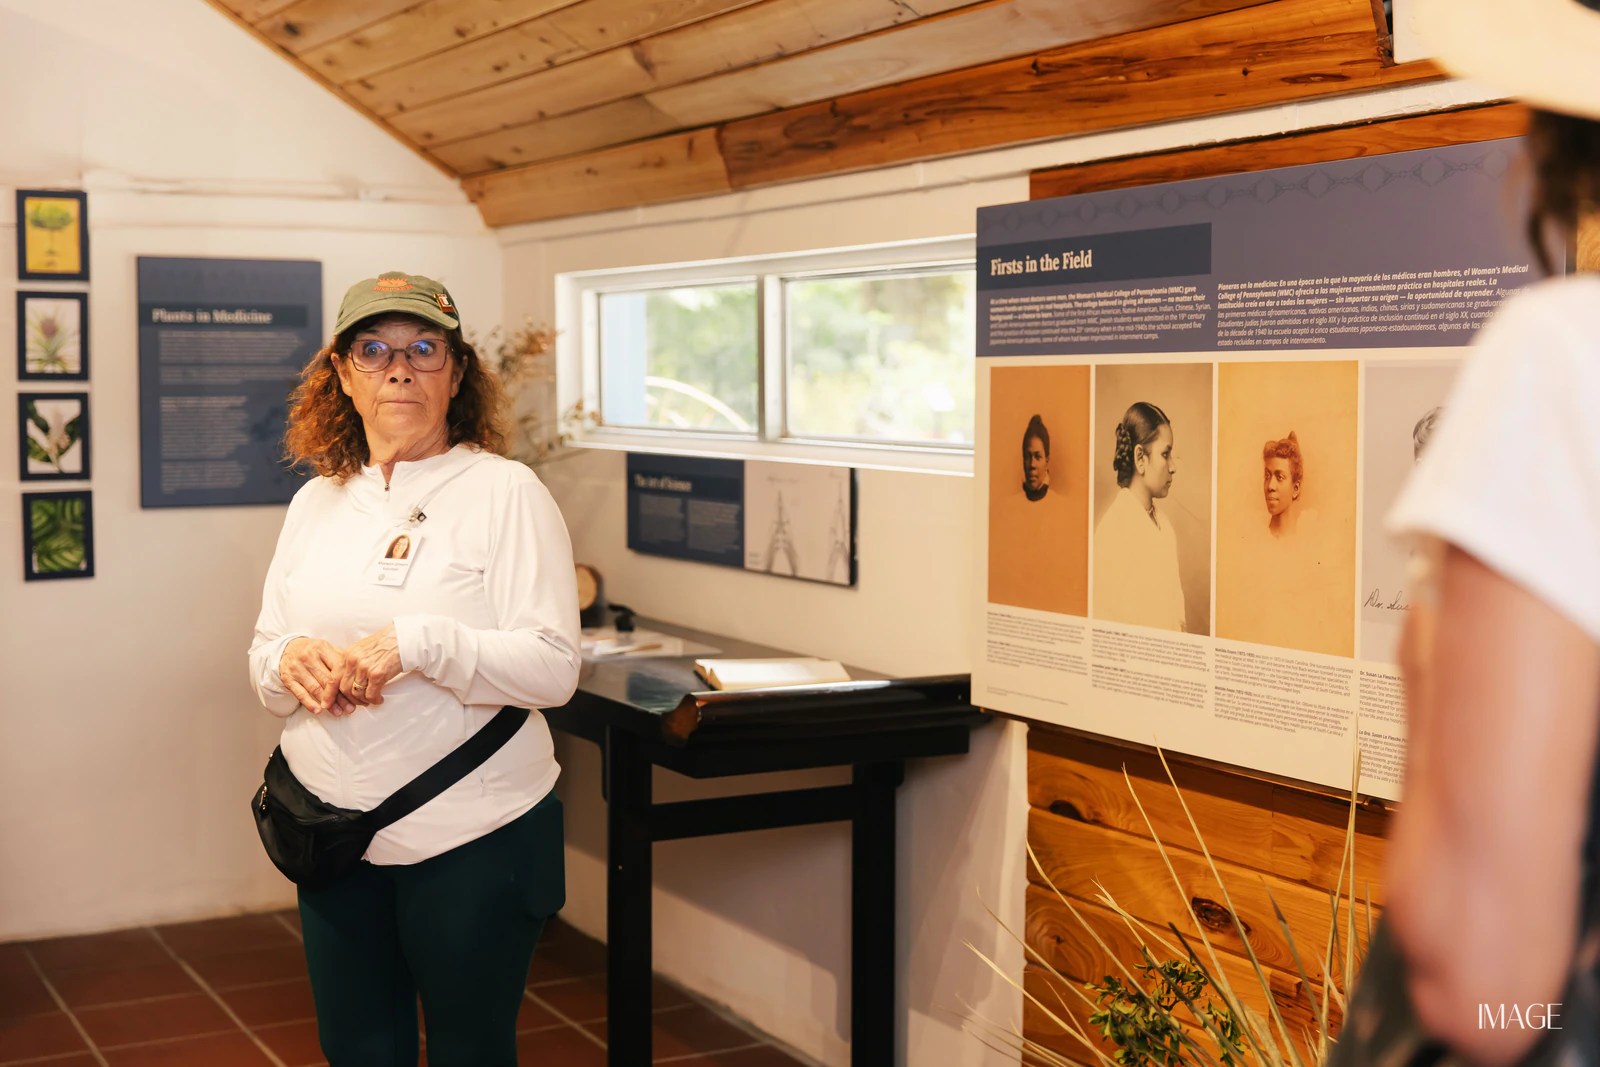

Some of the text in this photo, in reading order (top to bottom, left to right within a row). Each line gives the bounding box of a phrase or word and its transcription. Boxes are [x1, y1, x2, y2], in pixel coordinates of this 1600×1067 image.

[990, 248, 1093, 276] Firsts in the Field
[1218, 282, 1239, 290] Pioneras
[1247, 281, 1253, 289] la
[1280, 279, 1286, 287] En
[1299, 277, 1315, 287] época
[1324, 276, 1329, 284] la
[1330, 277, 1341, 286] que
[1342, 275, 1348, 283] la
[1348, 274, 1372, 285] mayoría
[1373, 273, 1381, 281] de
[1382, 273, 1391, 281] los
[1392, 271, 1417, 280] médicos
[1433, 269, 1462, 279] hombres,
[1464, 268, 1470, 276] el
[1502, 265, 1529, 274] Medical
[1185, 286, 1196, 294] gave
[1218, 291, 1236, 301] College
[1237, 291, 1243, 299] of
[1243, 289, 1276, 300] Pennsylvania
[1277, 288, 1295, 298] (WMC)
[1320, 286, 1328, 294] las
[1329, 285, 1352, 295] mujeres
[1353, 282, 1396, 292] entrenamiento
[1397, 281, 1422, 292] práctico
[1432, 278, 1465, 290] hospitales
[1466, 277, 1488, 286] reales.
[1489, 277, 1497, 285] La
[1175, 295, 1192, 303] matter
[1193, 294, 1206, 302] their
[1218, 301, 1244, 309] institución
[1266, 299, 1275, 307] dar
[1281, 298, 1296, 306] todas
[1306, 296, 1328, 307] mujeres
[1336, 296, 1344, 304] sin
[1345, 294, 1370, 305] importar
[1380, 293, 1399, 303] origen
[1407, 292, 1414, 300] la
[1414, 290, 1453, 302] oportunidad
[1454, 290, 1462, 298] de
[1464, 288, 1494, 299] aprender.
[152, 307, 274, 324] Plants in Medicine
[1196, 303, 1212, 312] Syrian,
[1225, 310, 1246, 320] primeras
[1308, 306, 1327, 315] nativas
[1328, 305, 1360, 315] americanas,
[1361, 304, 1378, 313] indias,
[1380, 303, 1399, 313] chinas,
[1400, 303, 1415, 311] sirias
[1416, 304, 1420, 312] y
[1420, 300, 1465, 310] sudamericanas
[1474, 299, 1507, 310] graduaro
[1188, 312, 1206, 321] century
[1218, 319, 1244, 327] Estudiantes
[1260, 318, 1276, 326] fueron
[1316, 316, 1327, 326] siglo
[1328, 316, 1337, 324] XIX
[1337, 317, 1341, 325] y
[1341, 315, 1347, 323] la
[1348, 314, 1370, 325] práctica
[1370, 314, 1378, 322] de
[1378, 313, 1403, 322] inclusión
[1404, 312, 1430, 321] continuó
[1439, 312, 1445, 320] el
[1445, 311, 1459, 321] siglo
[1460, 311, 1469, 320] XX,
[1470, 310, 1493, 319] cuando
[1218, 329, 1224, 337] de
[1230, 328, 1247, 336] década
[1248, 328, 1254, 336] de
[1274, 327, 1292, 335] escuela
[1292, 326, 1309, 336] aceptó
[1315, 326, 1328, 334] cinco
[1329, 325, 1359, 333] estudiantes
[1438, 321, 1462, 332] algunas
[1463, 321, 1470, 329] de
[1471, 321, 1480, 329] las
[1263, 339, 1282, 347] campos
[1290, 336, 1326, 344] internamiento.
[1387, 590, 1410, 611] Sus
